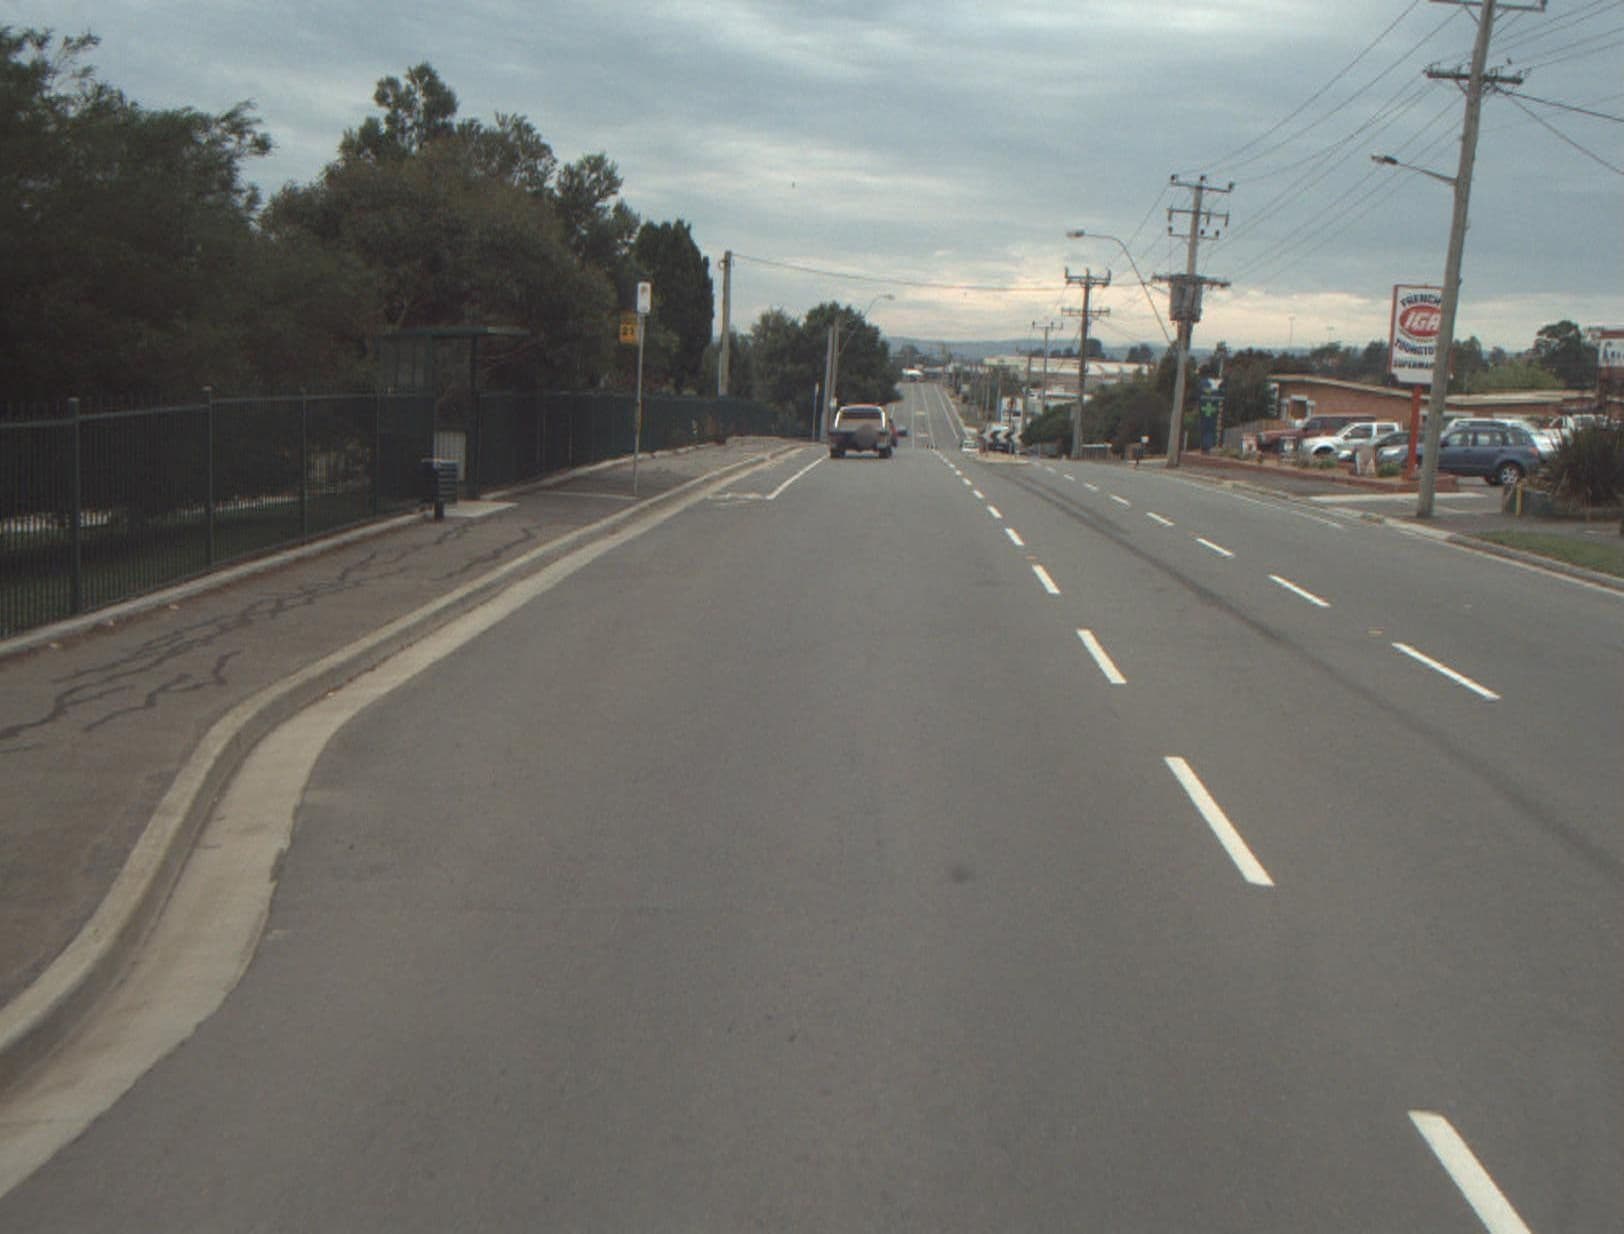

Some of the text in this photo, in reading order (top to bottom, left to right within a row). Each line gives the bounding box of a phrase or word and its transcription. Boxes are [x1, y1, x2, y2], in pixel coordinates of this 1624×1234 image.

[1404, 311, 1441, 331] IGA
[1394, 339, 1435, 356] YOUNGTO
[1393, 359, 1435, 369] SUPERMA
